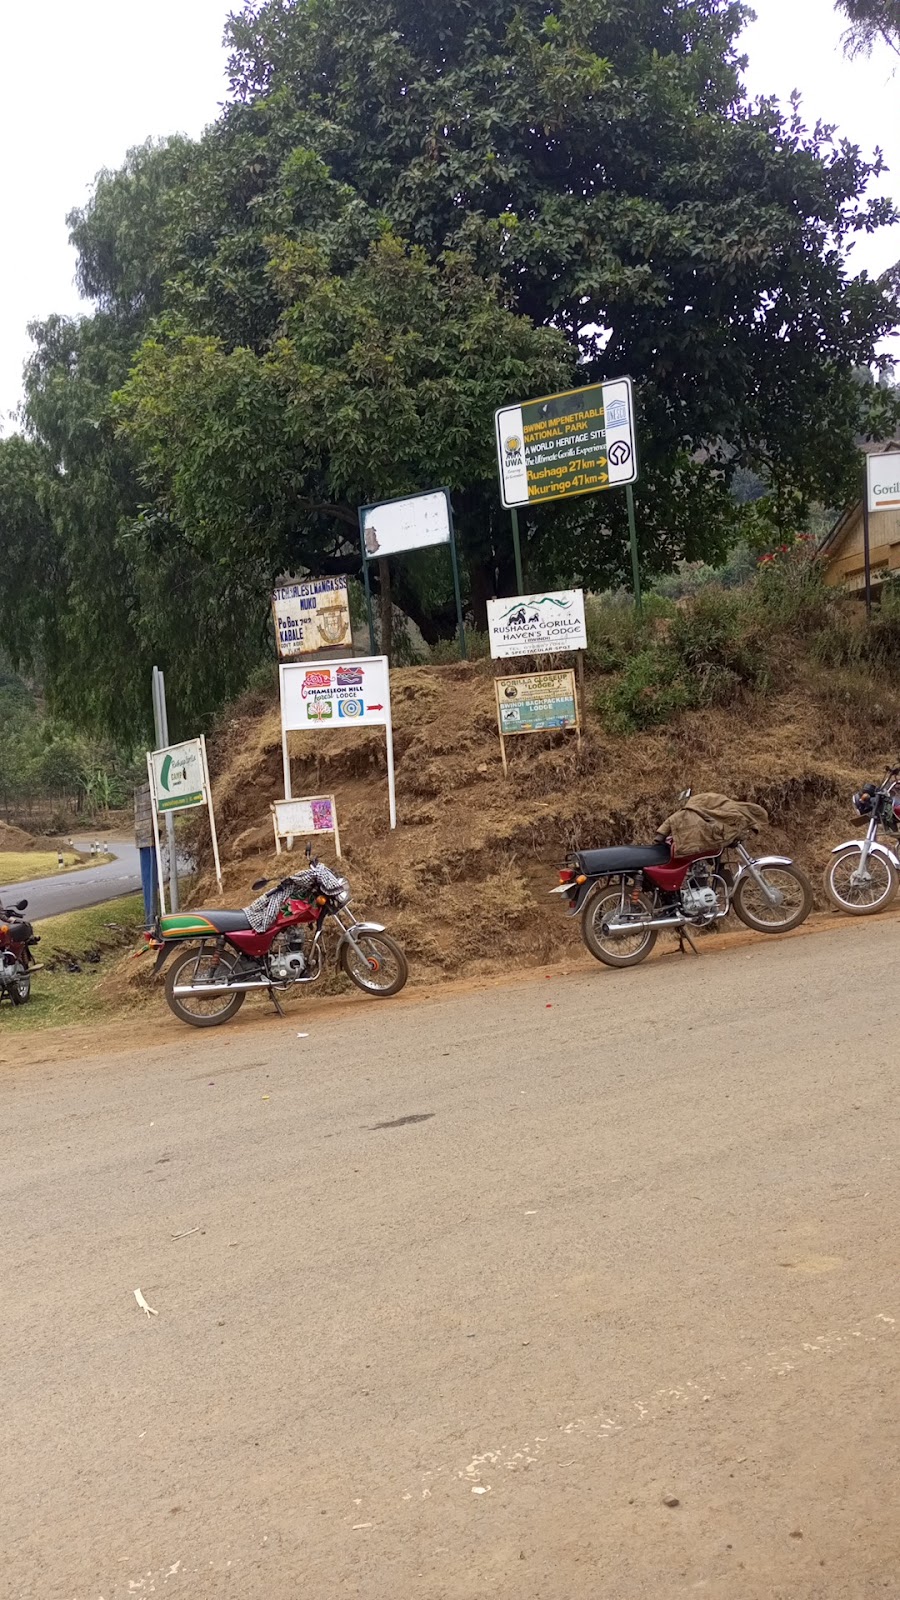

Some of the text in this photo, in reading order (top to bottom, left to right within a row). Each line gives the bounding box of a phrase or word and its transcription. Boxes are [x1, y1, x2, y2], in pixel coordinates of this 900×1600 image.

[523, 408, 604, 433] BWINDI IMPENETRABLE
[607, 408, 627, 422] UNESCO
[524, 421, 588, 443] NATIONAL PARK
[525, 429, 606, 455] A WORLD HERITAGE SITE
[505, 458, 523, 468] UWA
[535, 451, 558, 465] Ultimate
[558, 448, 575, 460] Gorilla
[527, 466, 568, 481] Rushaga
[528, 480, 571, 496] Nkuringo
[873, 482, 900, 496] Goril
[300, 597, 316, 611] MUKO
[493, 618, 581, 634] RUSHAGA GORILLA
[279, 628, 304, 643] KABALE
[503, 626, 581, 641] HAVEN'S LODGE
[512, 646, 553, 655] SPECTACULAR
[500, 674, 568, 687] GORILLA CLOSEUP
[528, 682, 553, 690] LODGE
[525, 696, 574, 707] BACKPACKERS
[529, 704, 553, 712] LODGE
